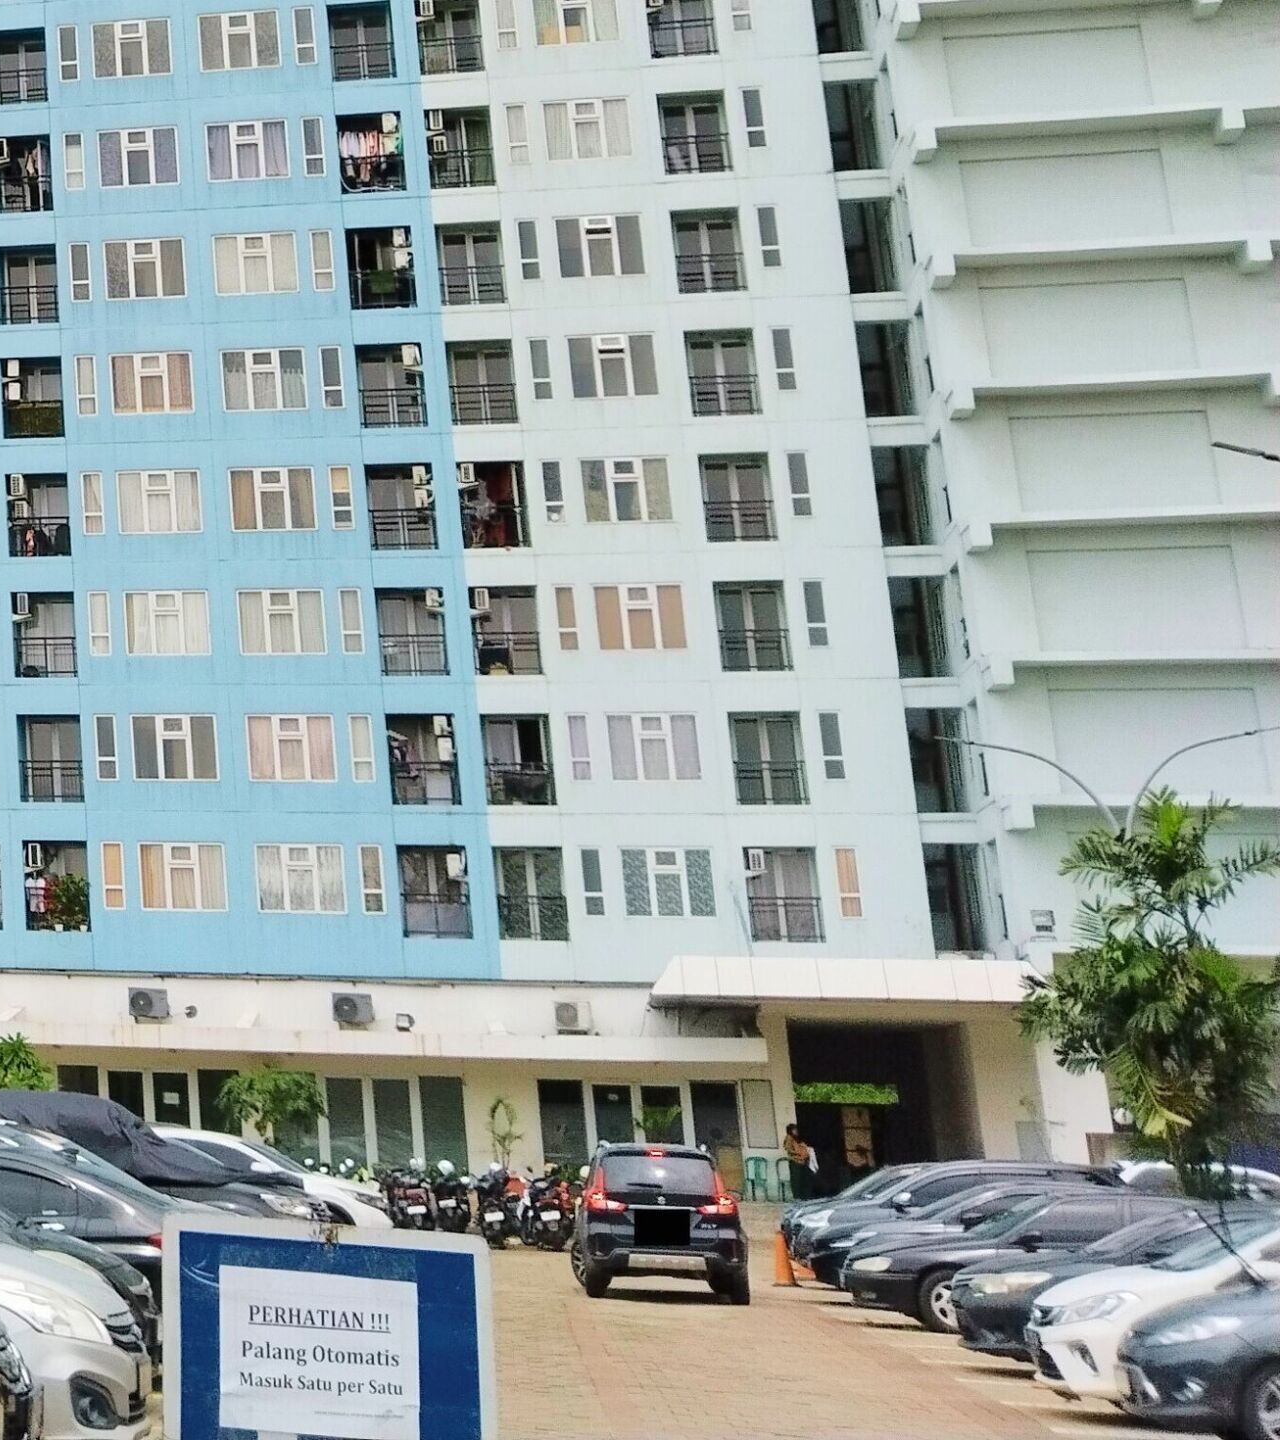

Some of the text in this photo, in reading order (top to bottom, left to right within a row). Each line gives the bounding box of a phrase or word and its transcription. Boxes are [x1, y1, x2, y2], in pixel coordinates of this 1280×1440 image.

[248, 1305, 391, 1331] PERHATIAN !!!
[241, 1340, 401, 1367] Palang Otomatis
[239, 1371, 404, 1396] Masuk Satu per Satu
